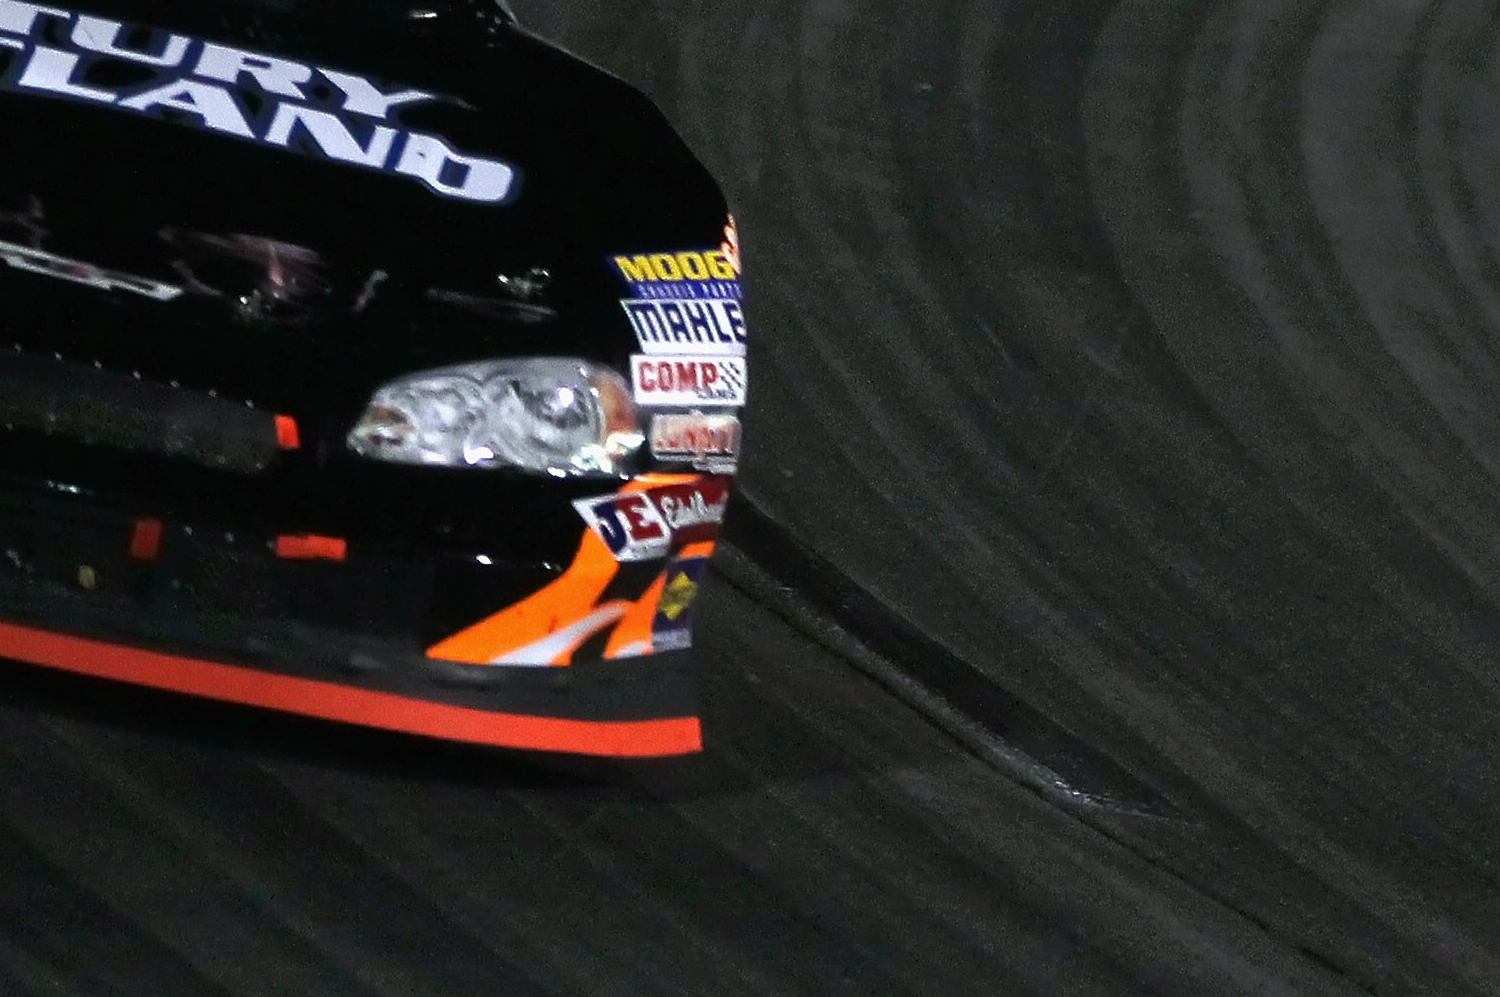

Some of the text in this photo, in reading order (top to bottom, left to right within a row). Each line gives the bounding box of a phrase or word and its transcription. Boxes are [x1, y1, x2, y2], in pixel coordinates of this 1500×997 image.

[614, 250, 737, 283] MOOG
[629, 302, 747, 343] MAHLE
[637, 361, 719, 393] COMP
[592, 496, 665, 554] JE
